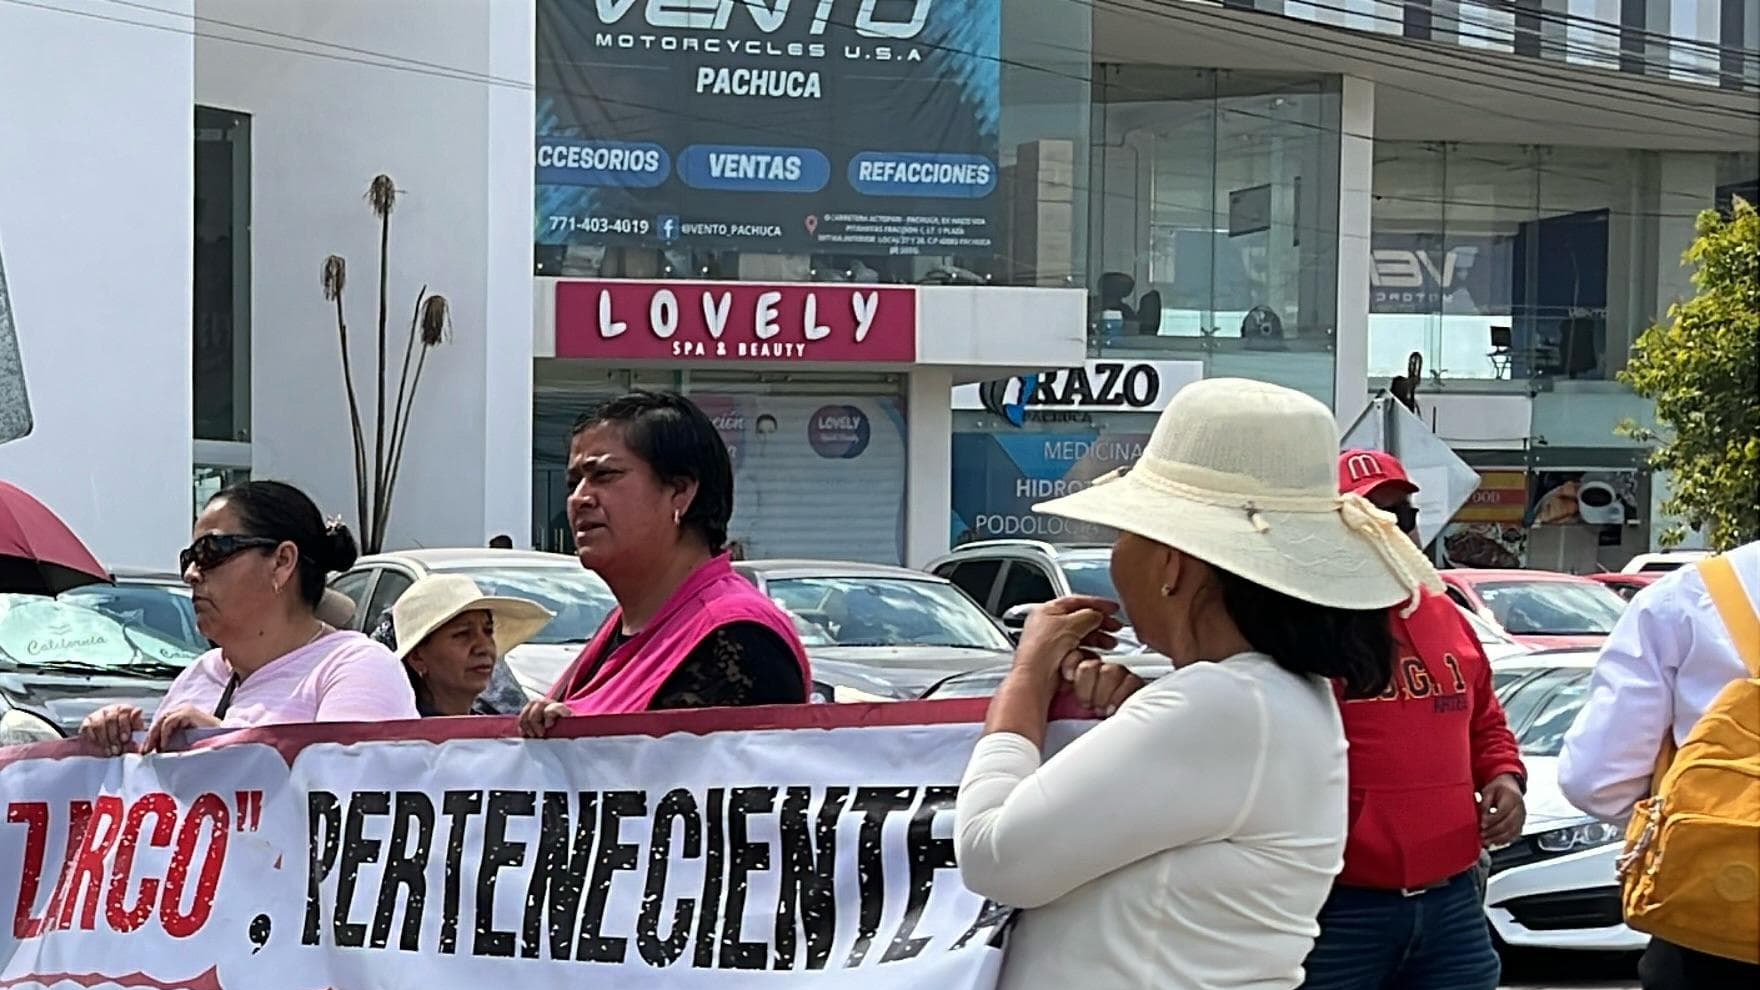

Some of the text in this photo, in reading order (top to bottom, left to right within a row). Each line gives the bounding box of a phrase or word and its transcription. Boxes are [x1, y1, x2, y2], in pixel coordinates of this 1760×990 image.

[595, 32, 922, 61] MOTORCYCLES U.S.A
[696, 67, 822, 98] PACHUCA
[537, 145, 659, 172] CCESORIOS
[709, 153, 801, 181] VENTAS
[859, 162, 990, 185] REFACCIONES
[550, 217, 782, 238] 771-403-4019 @VENTO_PACHUCA
[598, 289, 879, 342] LOVELY
[672, 342, 805, 358] SPA & BEAUTY
[818, 416, 861, 430] LOVELY
[1044, 441, 1143, 461] MEDICINA
[1016, 479, 1091, 498] HIDRO
[301, 785, 961, 971] PERTENECIENTE
